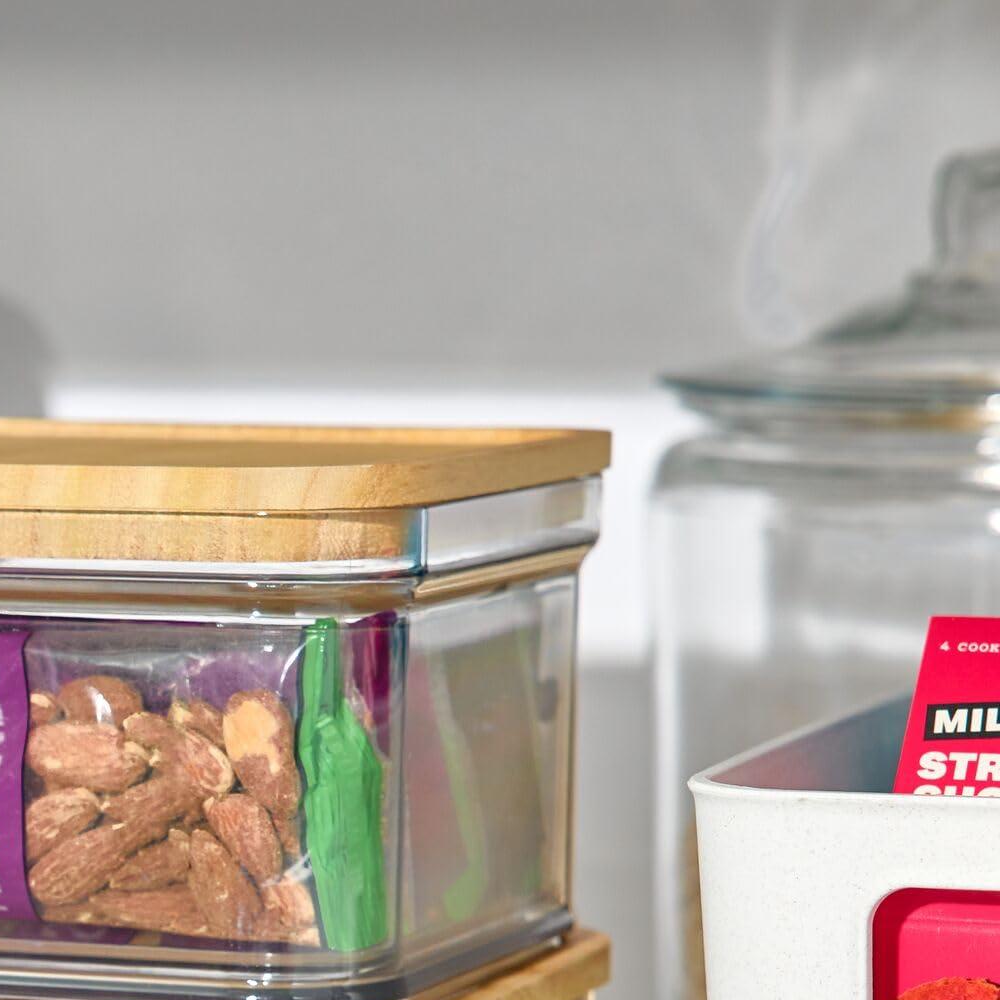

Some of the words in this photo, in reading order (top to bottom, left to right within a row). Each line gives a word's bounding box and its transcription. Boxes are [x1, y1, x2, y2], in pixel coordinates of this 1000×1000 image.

[939, 641, 950, 651] 4
[957, 642, 1000, 653] COOK
[917, 751, 1000, 782] STR
